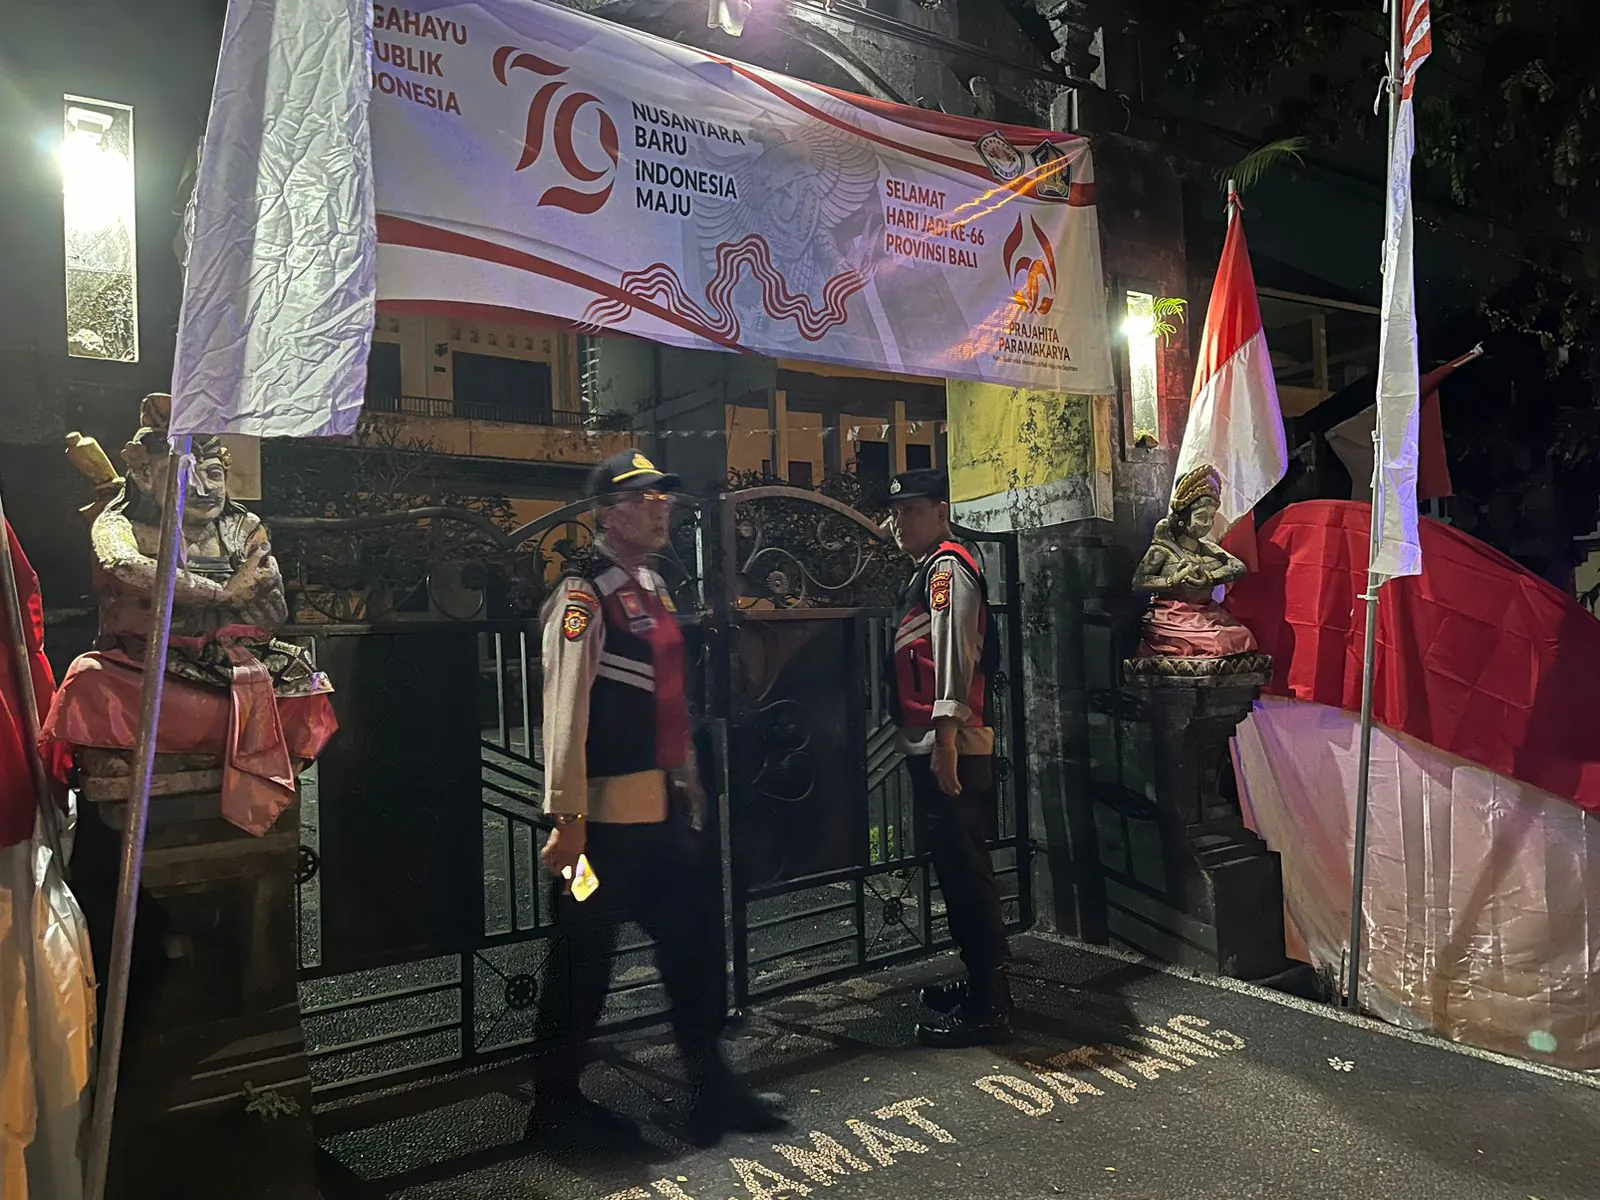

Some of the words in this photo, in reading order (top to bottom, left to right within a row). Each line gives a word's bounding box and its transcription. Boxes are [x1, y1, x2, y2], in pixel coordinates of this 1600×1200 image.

[492, 45, 620, 215] 79
[631, 100, 746, 147] NUSANTARA
[635, 125, 687, 156] BARU
[635, 159, 738, 200] INDONESIA
[886, 179, 946, 210] SELAMAT
[636, 187, 691, 217] MAJU
[886, 206, 918, 231] HARI
[921, 214, 948, 239] JADI
[950, 224, 985, 246] KE-66
[886, 233, 946, 263] PROVINSI
[948, 247, 978, 269] BALI
[998, 336, 1071, 362] PARAMAKARYA
[1009, 321, 1060, 344] PRAJAHITA
[972, 1013, 1246, 1118] DATANG
